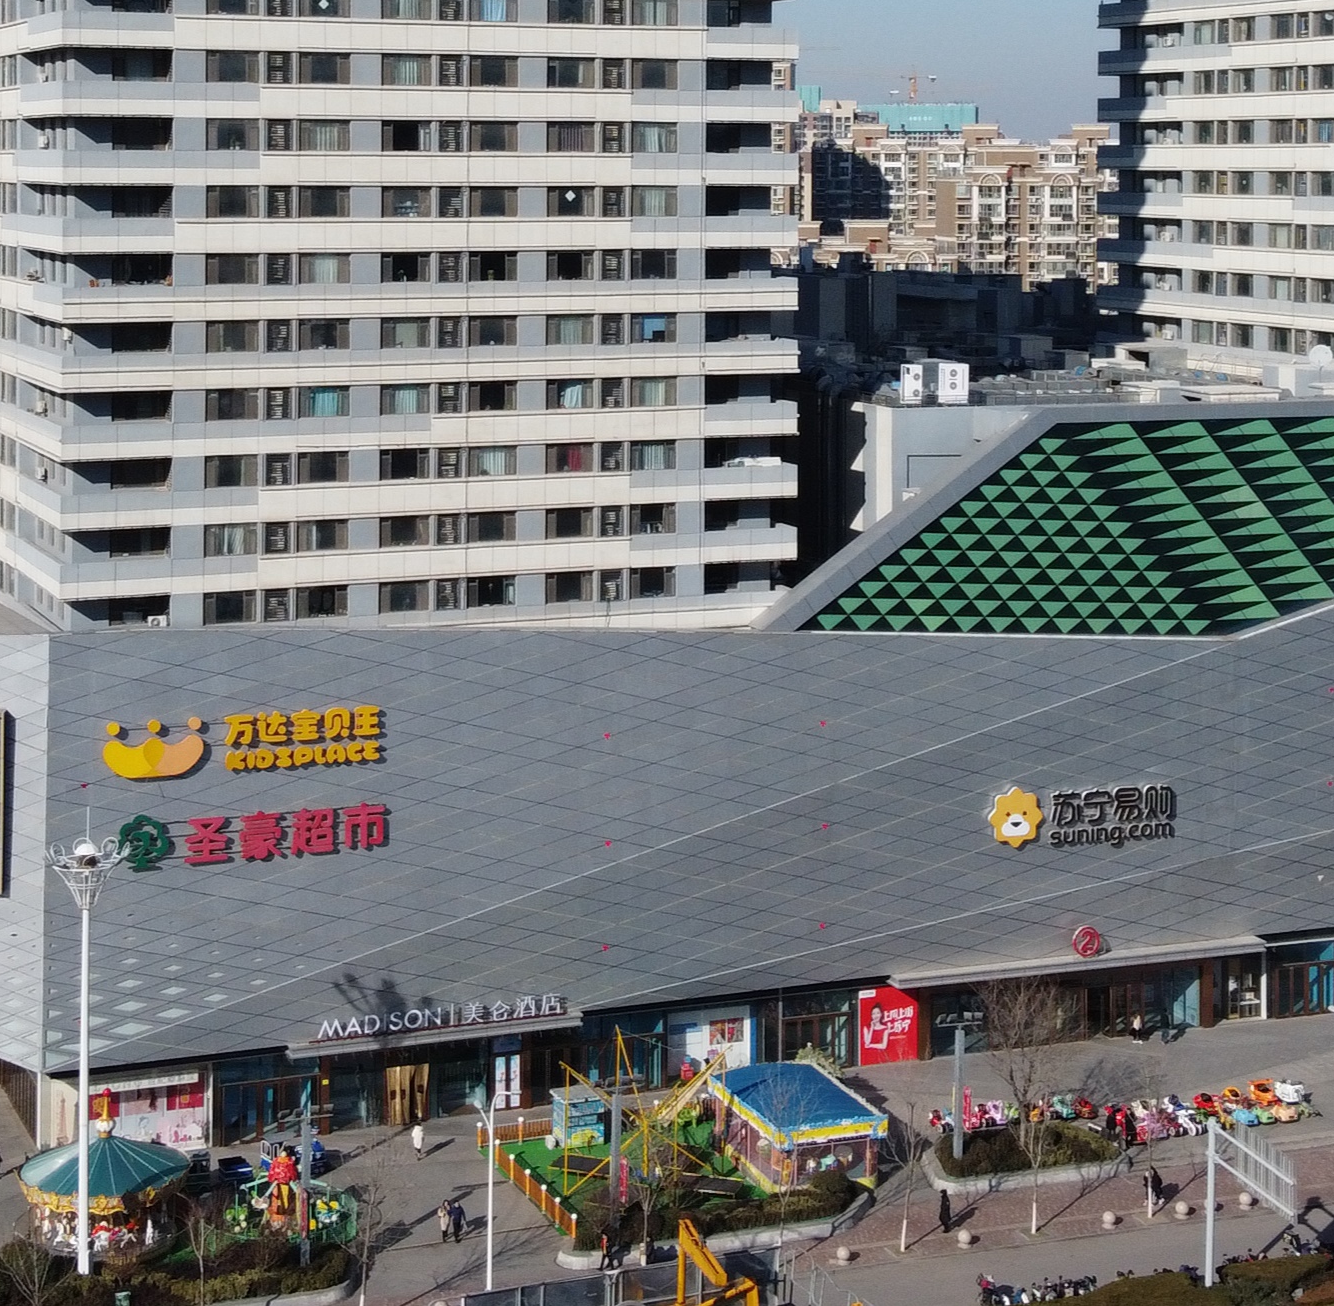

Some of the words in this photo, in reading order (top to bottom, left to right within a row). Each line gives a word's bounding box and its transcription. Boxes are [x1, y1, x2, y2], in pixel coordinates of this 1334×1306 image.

[224, 705, 380, 745] 万达宝贝王
[225, 741, 380, 771] KIDSPLACE
[1050, 784, 1173, 826] 苏宁易购
[184, 802, 386, 863] 圣豪超市
[1049, 822, 1173, 847] suning.com
[317, 1007, 442, 1039] MADISON
[463, 993, 564, 1024] 美仑酒店
